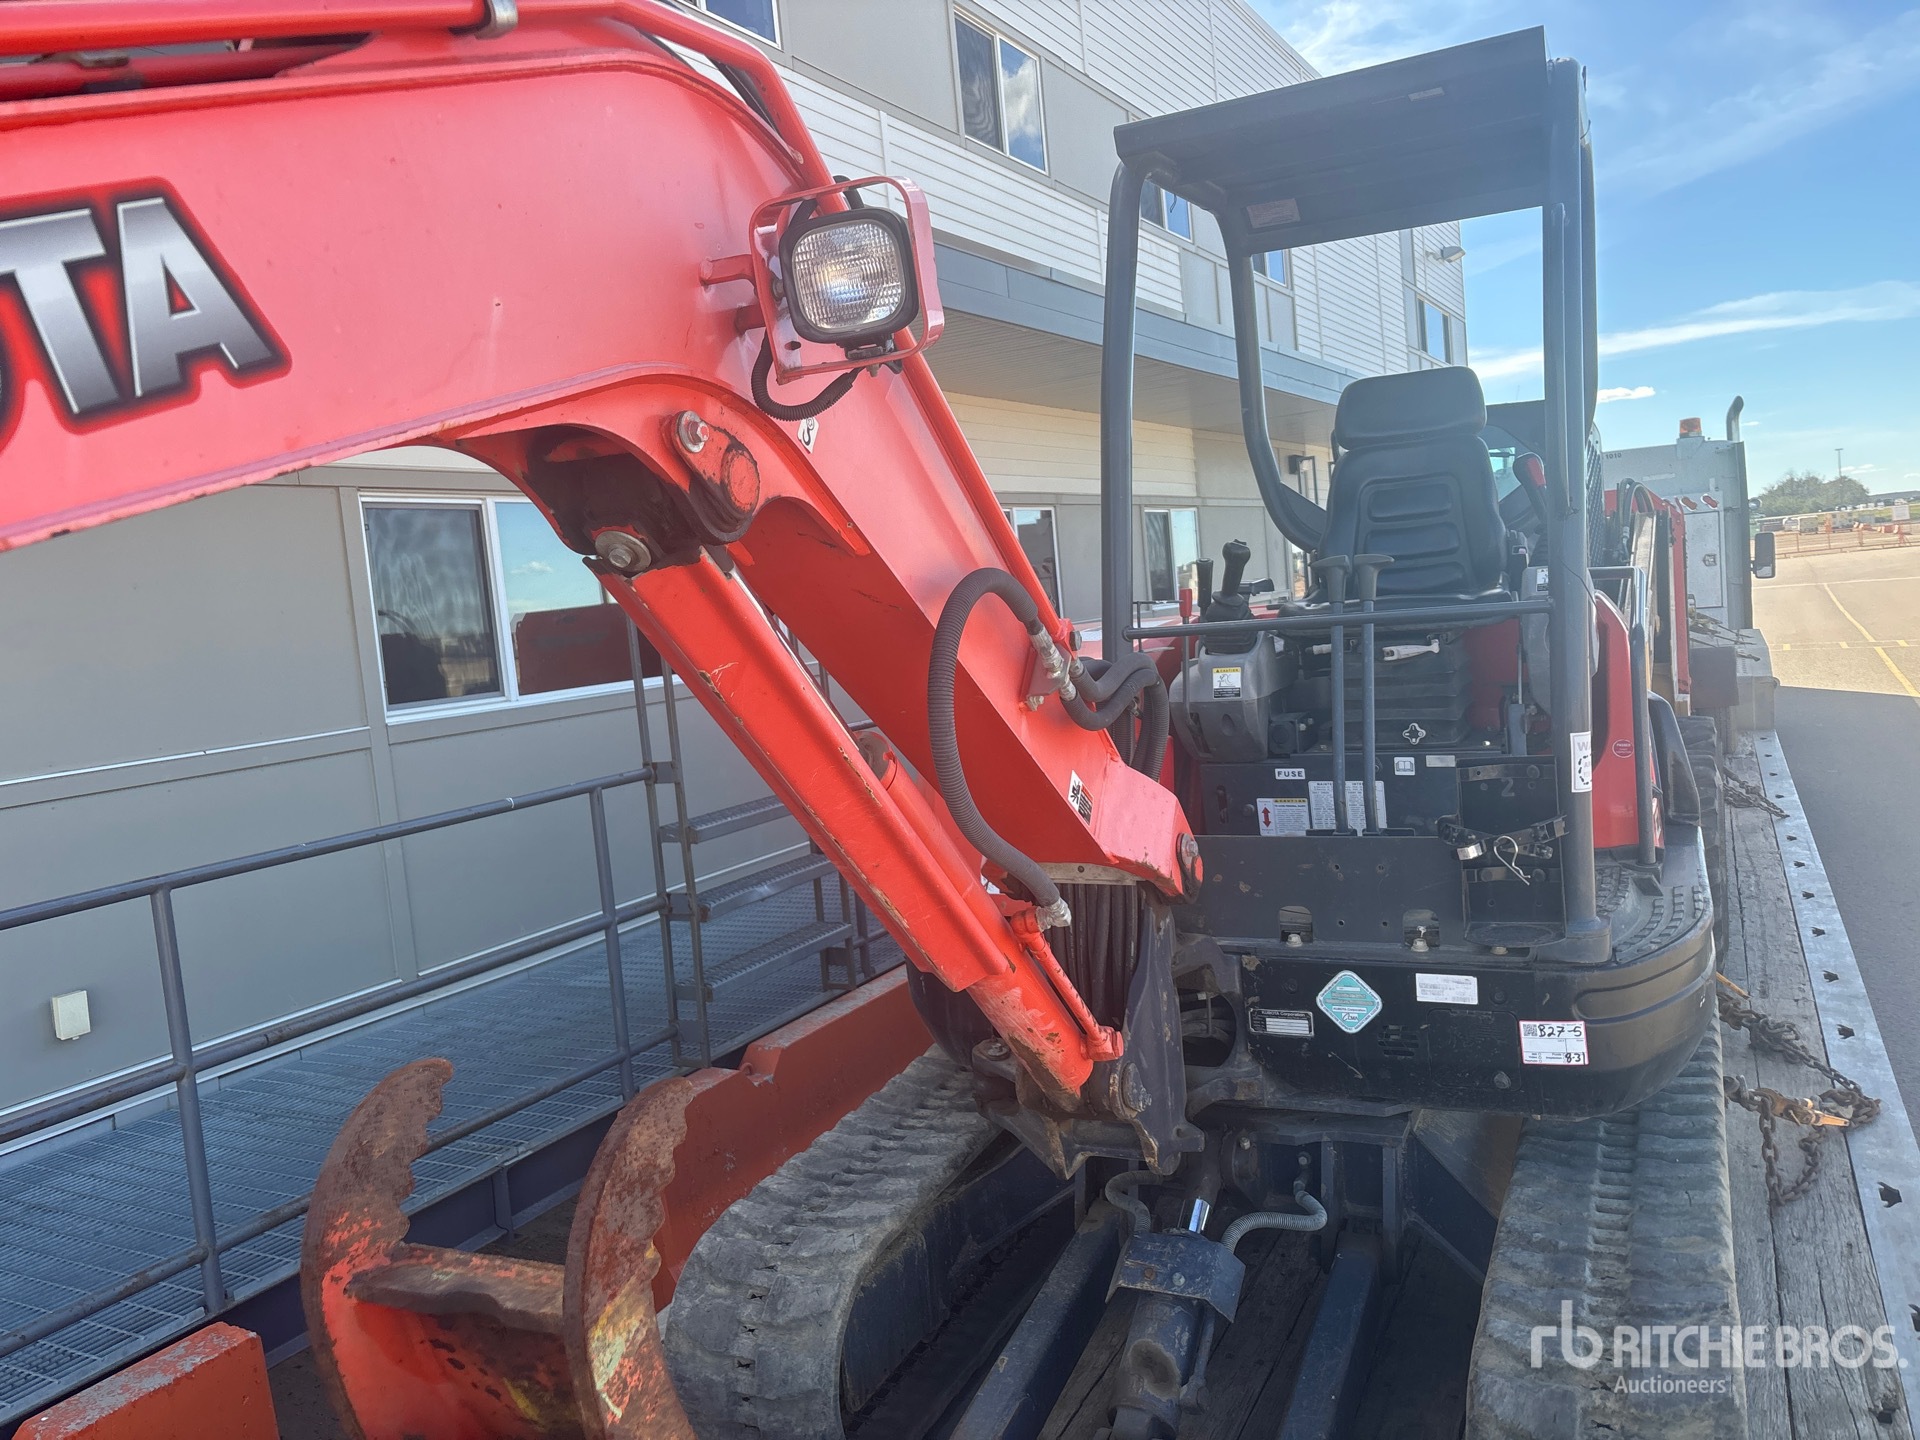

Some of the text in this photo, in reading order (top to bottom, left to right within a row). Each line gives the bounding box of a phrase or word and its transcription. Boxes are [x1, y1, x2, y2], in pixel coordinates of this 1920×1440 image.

[1577, 742, 1591, 752] W
[1277, 770, 1303, 778] FUSE
[1501, 777, 1515, 797] 2
